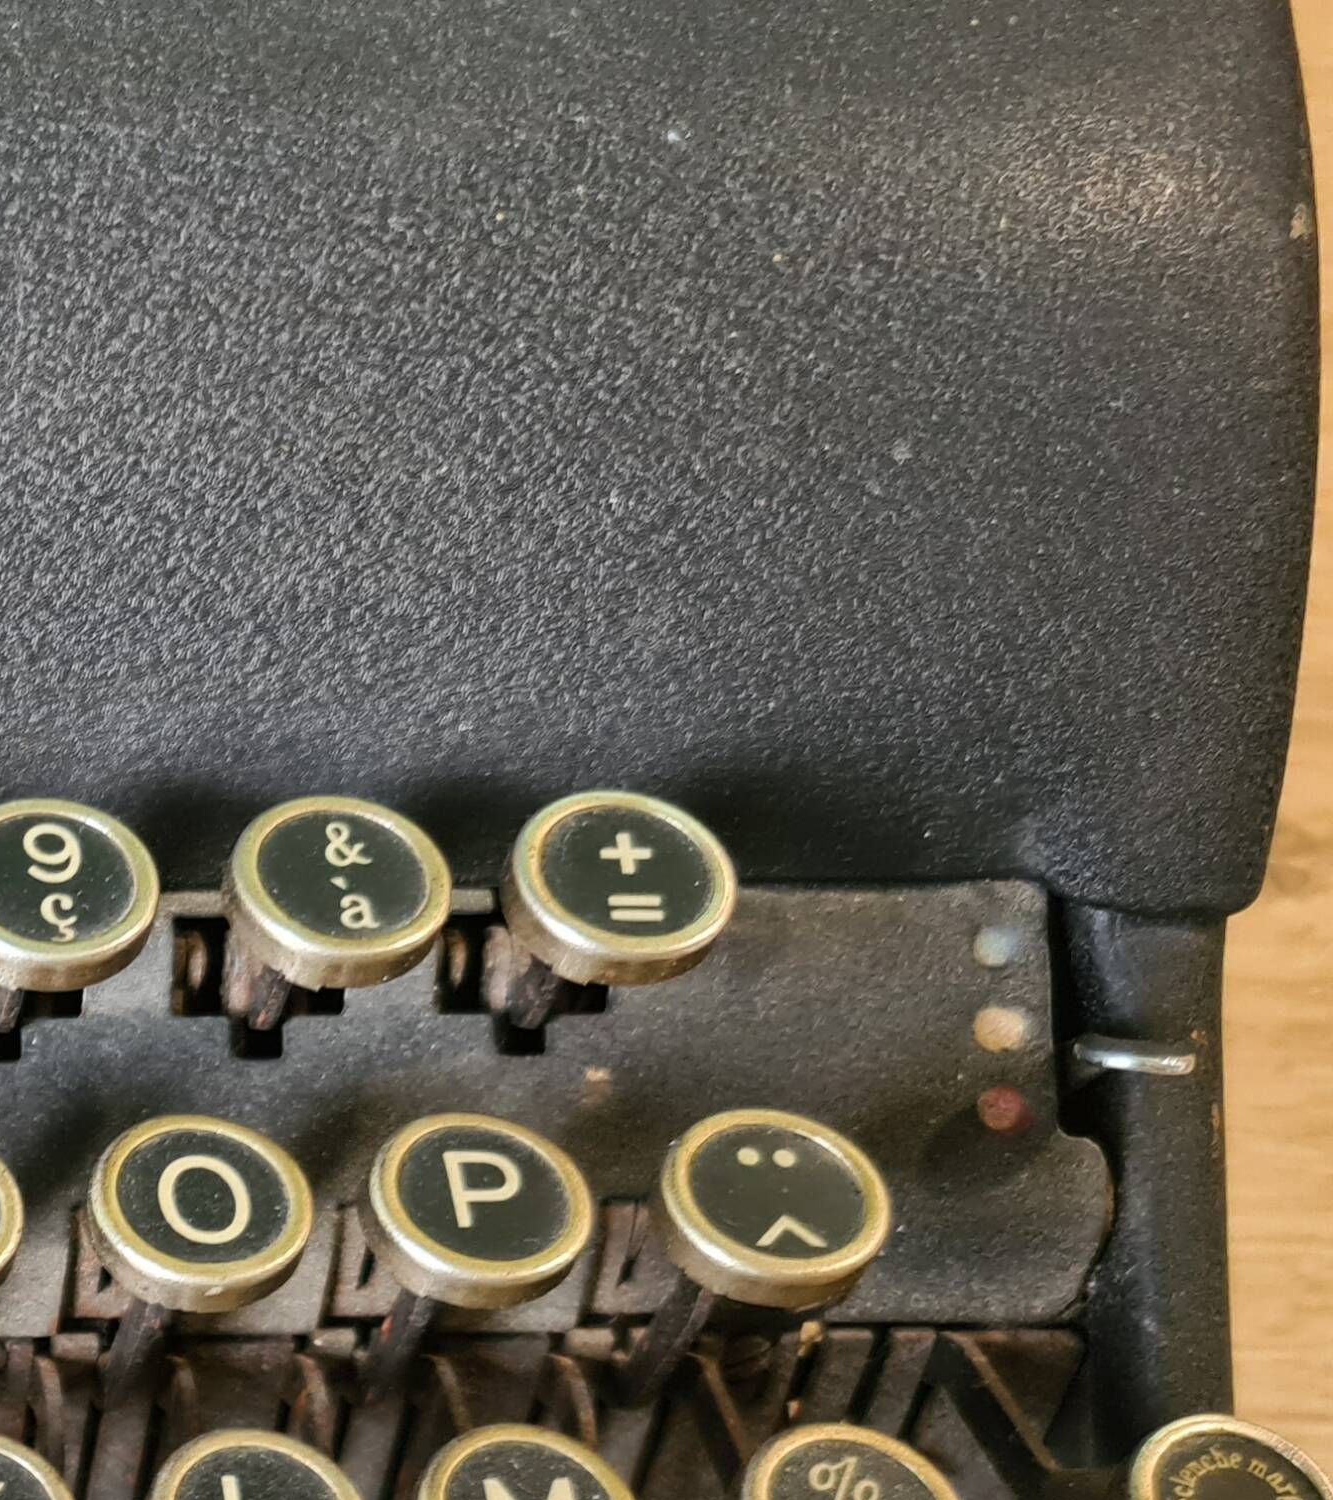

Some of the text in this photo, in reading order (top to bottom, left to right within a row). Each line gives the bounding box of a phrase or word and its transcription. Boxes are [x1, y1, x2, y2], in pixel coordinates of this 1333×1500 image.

[23, 823, 81, 883] 9
[325, 822, 371, 866] &
[600, 832, 652, 874] +
[41, 894, 77, 942] ç
[330, 877, 381, 929] à
[608, 895, 664, 921] =
[158, 1155, 250, 1244] O
[443, 1151, 521, 1227] P
